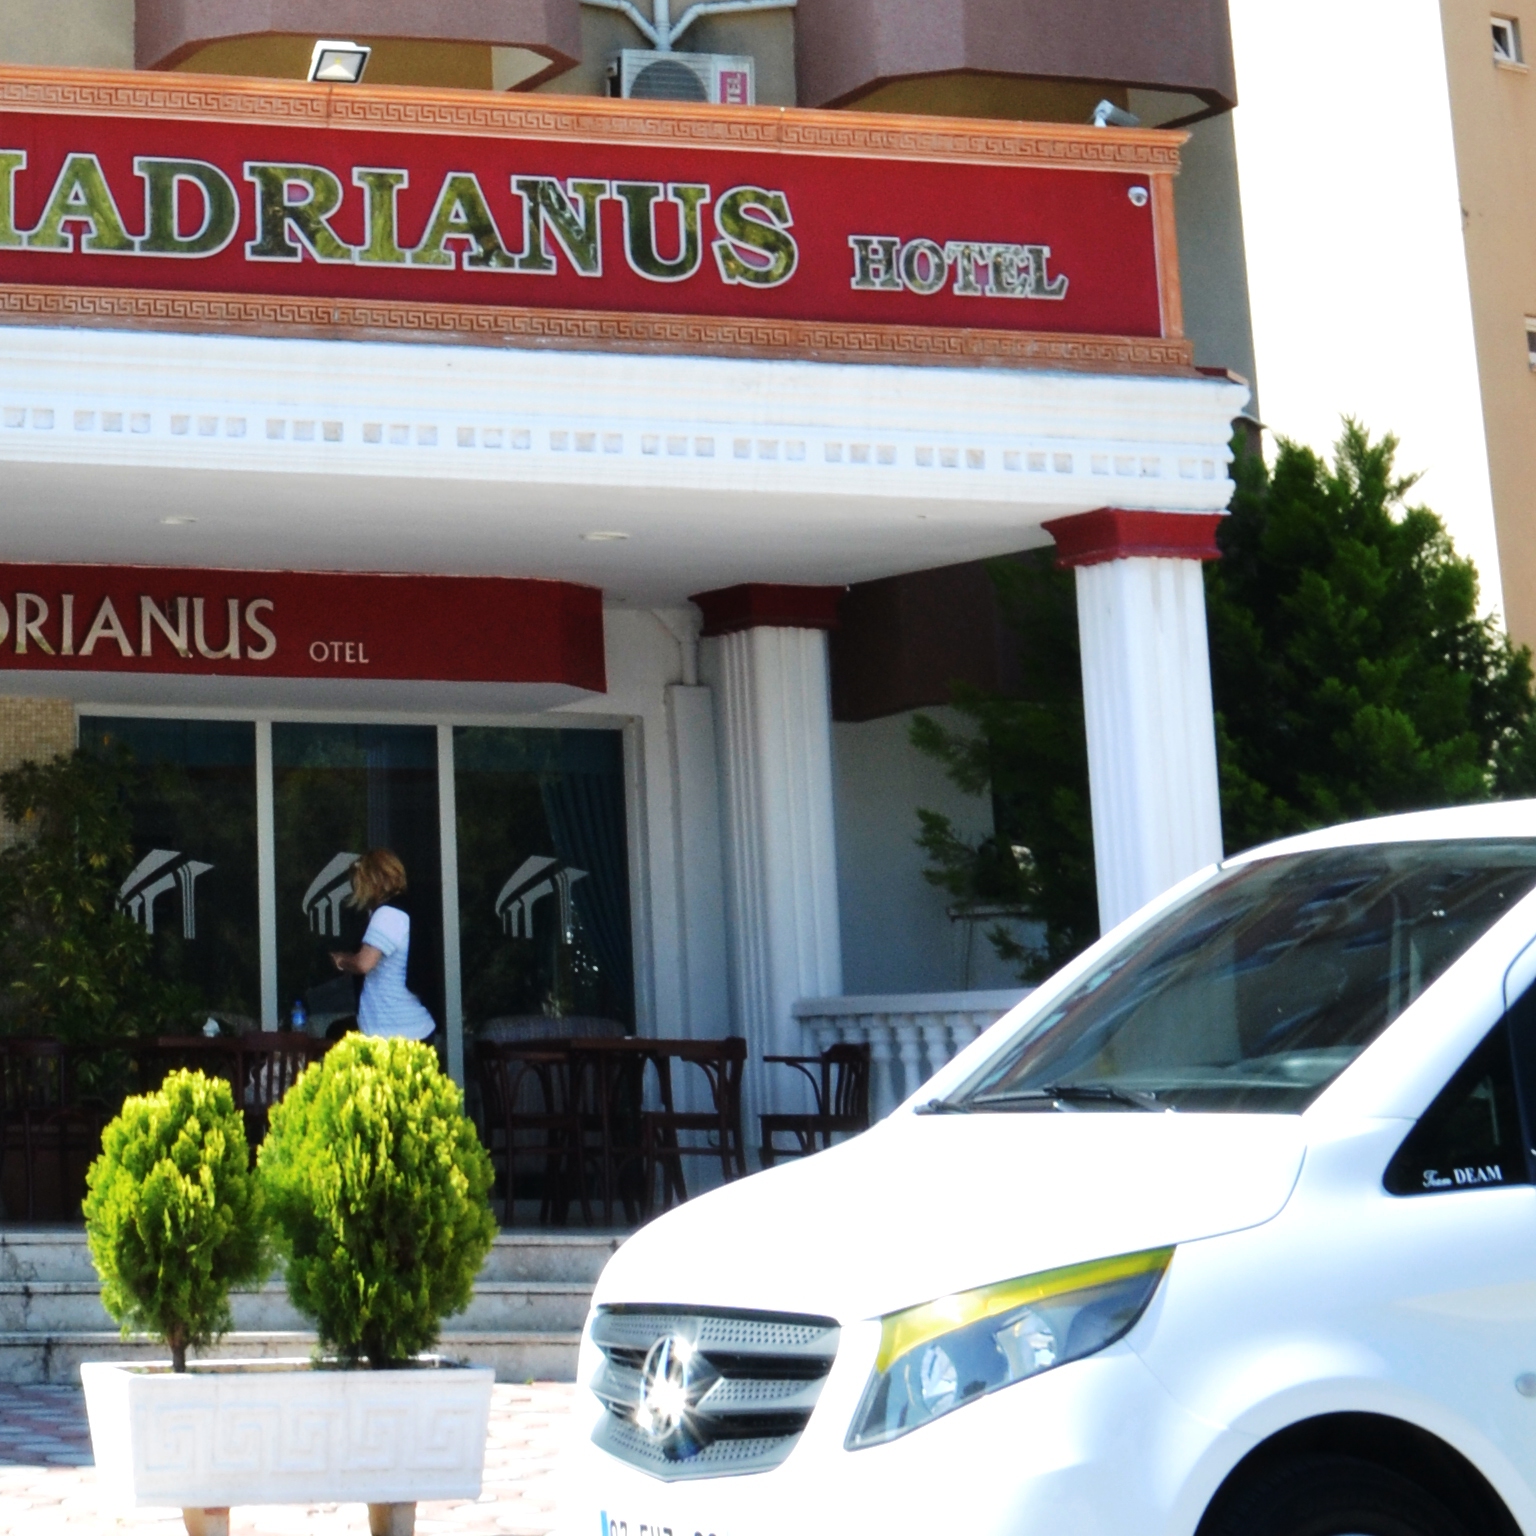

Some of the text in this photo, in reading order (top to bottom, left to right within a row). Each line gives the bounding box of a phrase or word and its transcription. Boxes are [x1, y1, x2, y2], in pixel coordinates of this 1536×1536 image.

[726, 72, 742, 104] TEL
[848, 234, 1069, 301] HOTEL
[308, 640, 370, 665] OTEL
